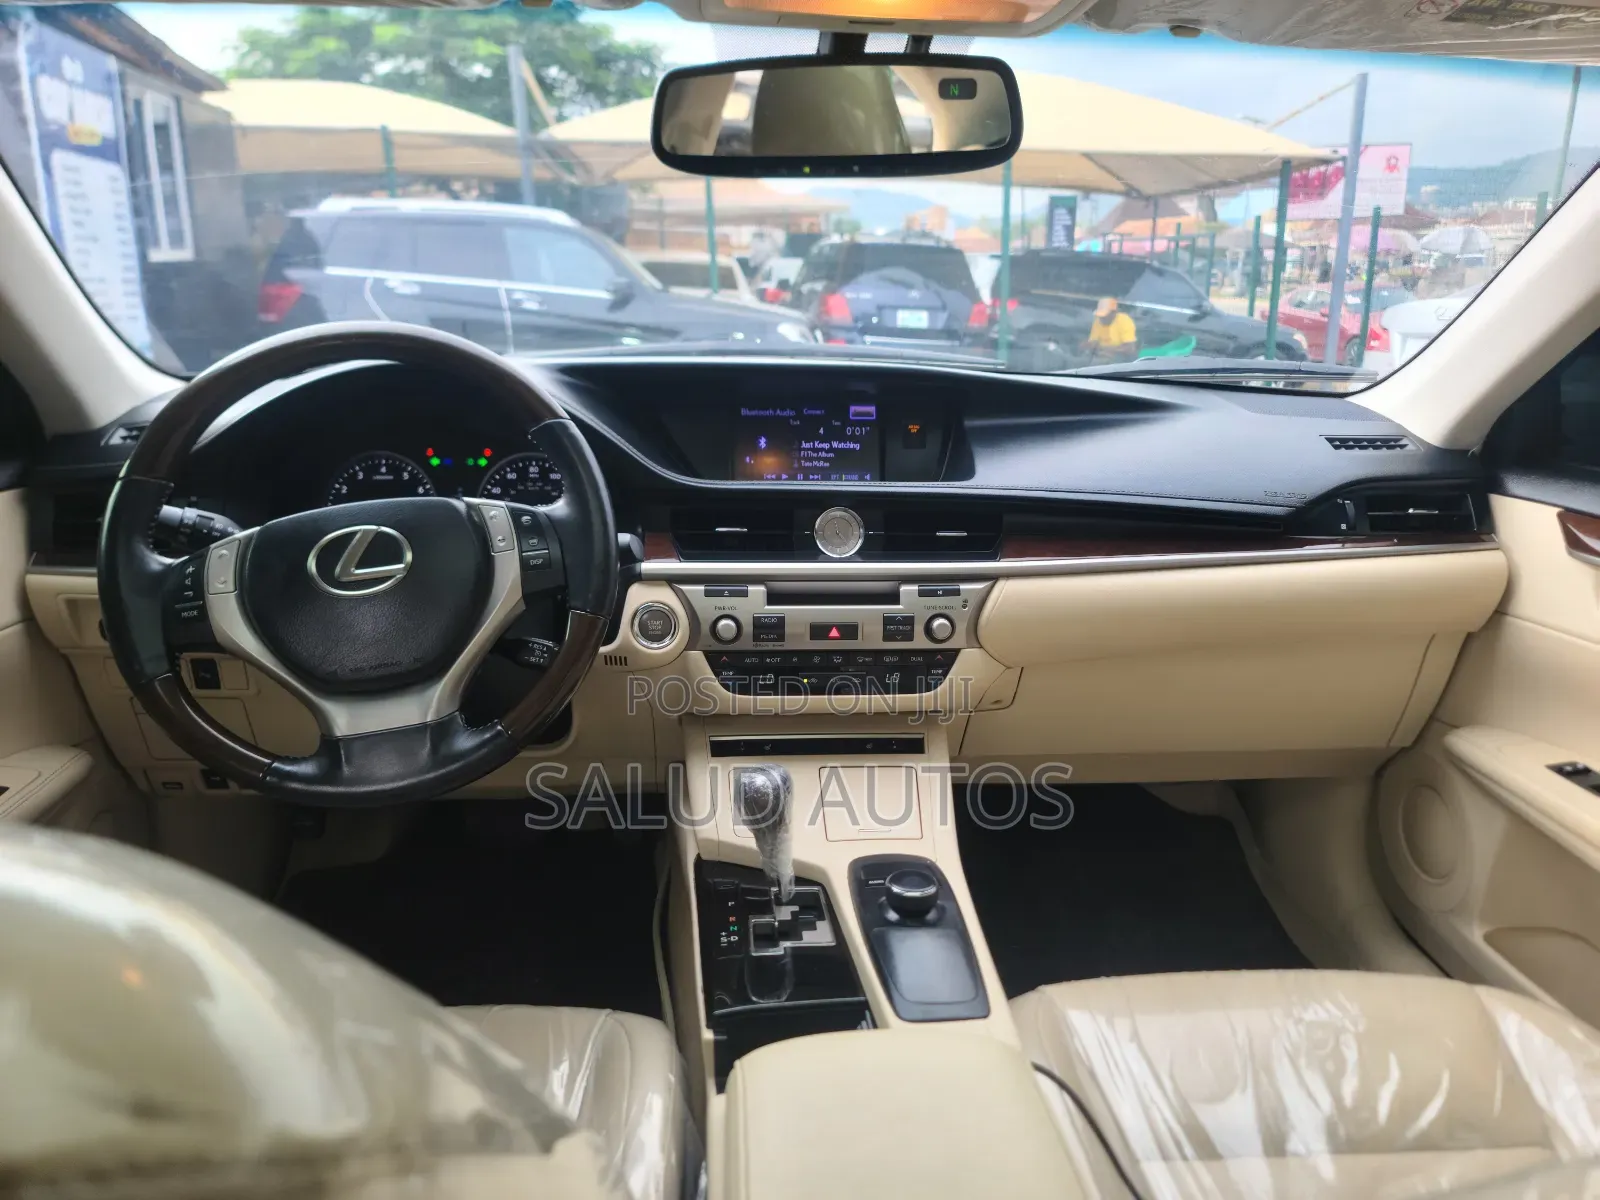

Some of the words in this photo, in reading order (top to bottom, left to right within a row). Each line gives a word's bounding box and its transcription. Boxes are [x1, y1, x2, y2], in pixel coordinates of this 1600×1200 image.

[950, 84, 958, 96] N
[741, 408, 774, 416] Bluetooth
[776, 408, 796, 416] Audio
[814, 441, 830, 450] Keep
[831, 441, 860, 450] Watching
[357, 472, 364, 480] 3
[402, 472, 409, 480] 5
[341, 485, 348, 494] 2
[417, 486, 424, 494] 6
